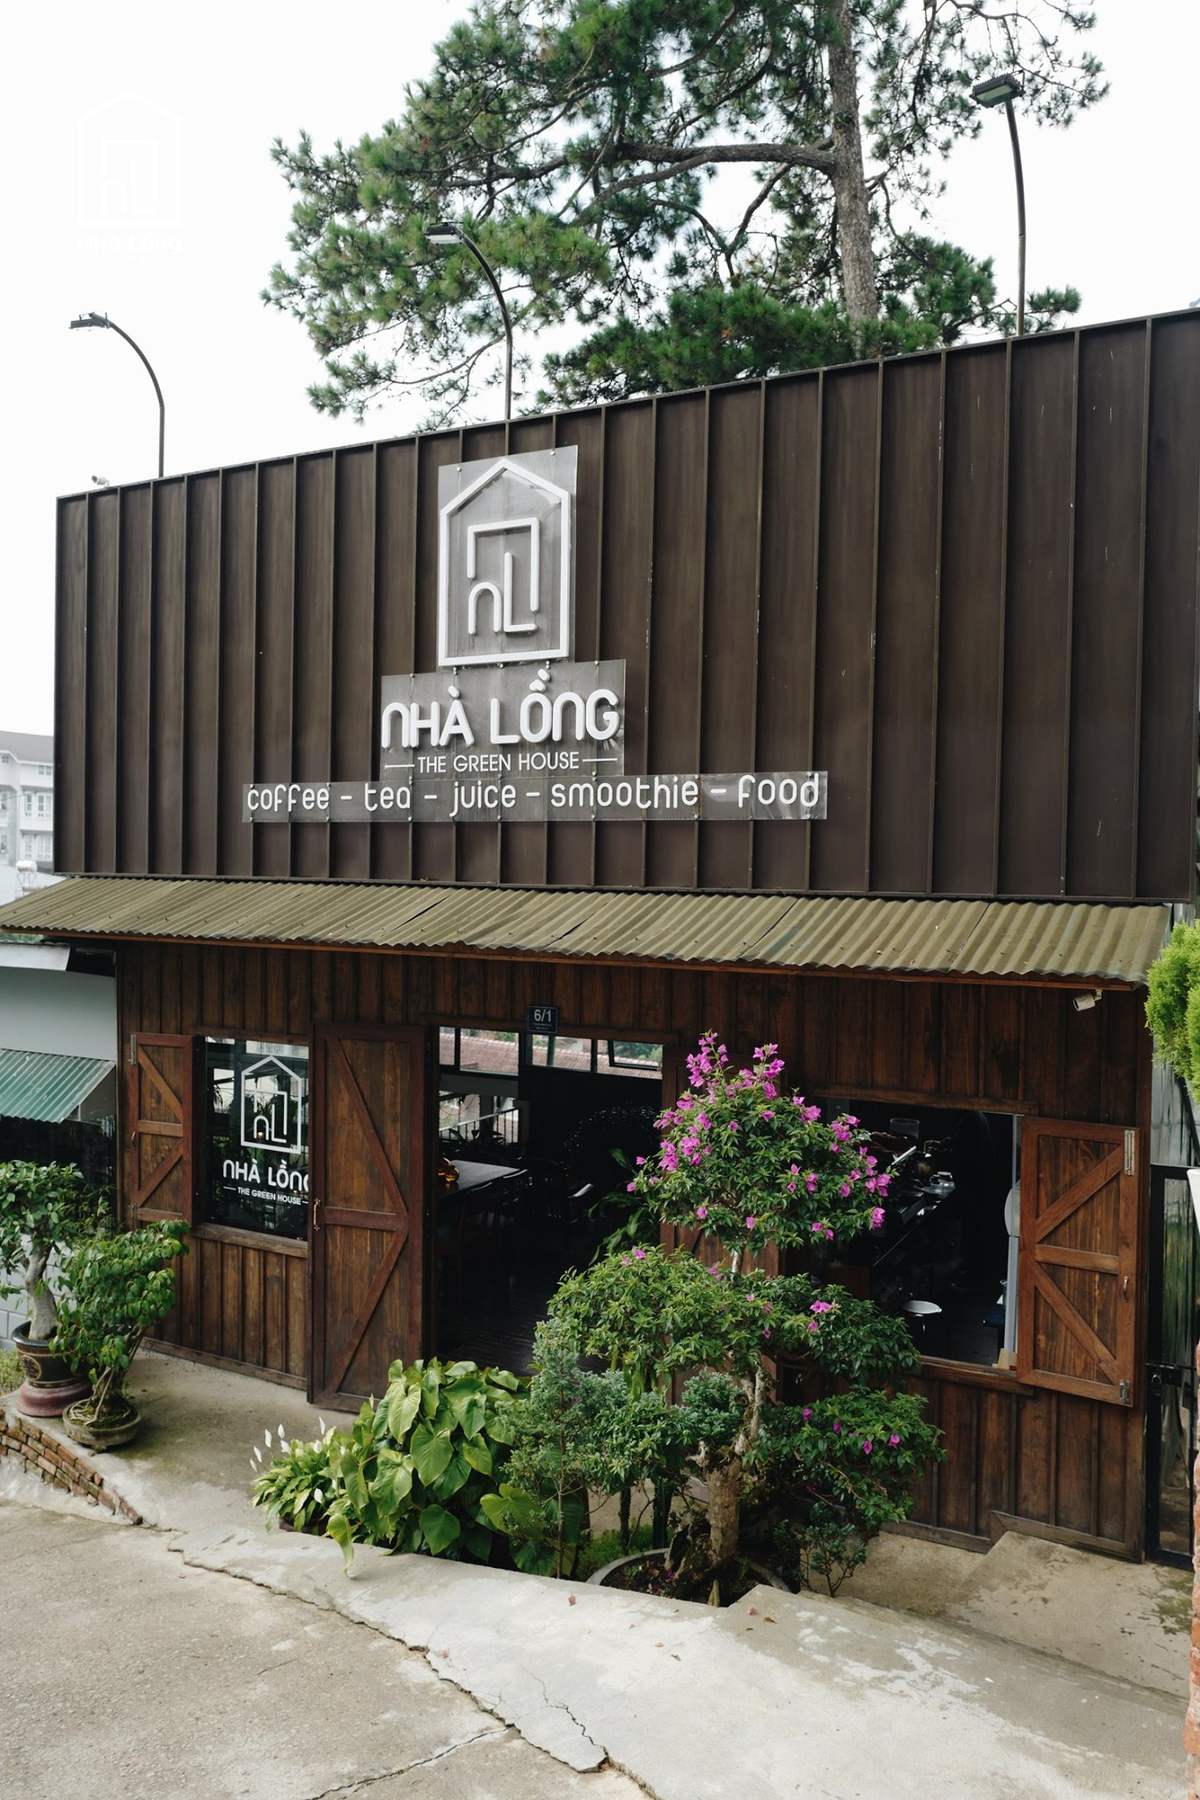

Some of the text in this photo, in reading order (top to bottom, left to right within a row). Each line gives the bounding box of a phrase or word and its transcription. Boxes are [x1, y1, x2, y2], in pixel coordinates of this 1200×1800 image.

[417, 751, 580, 774] THE GREEN HOUSE
[247, 783, 330, 813] coffee
[364, 782, 412, 812] tea
[449, 780, 517, 818] juice
[550, 775, 699, 810] smoothie
[738, 772, 820, 809] food
[533, 1008, 553, 1023] 6/1
[237, 1186, 302, 1206] THE GREEN HOUSE
